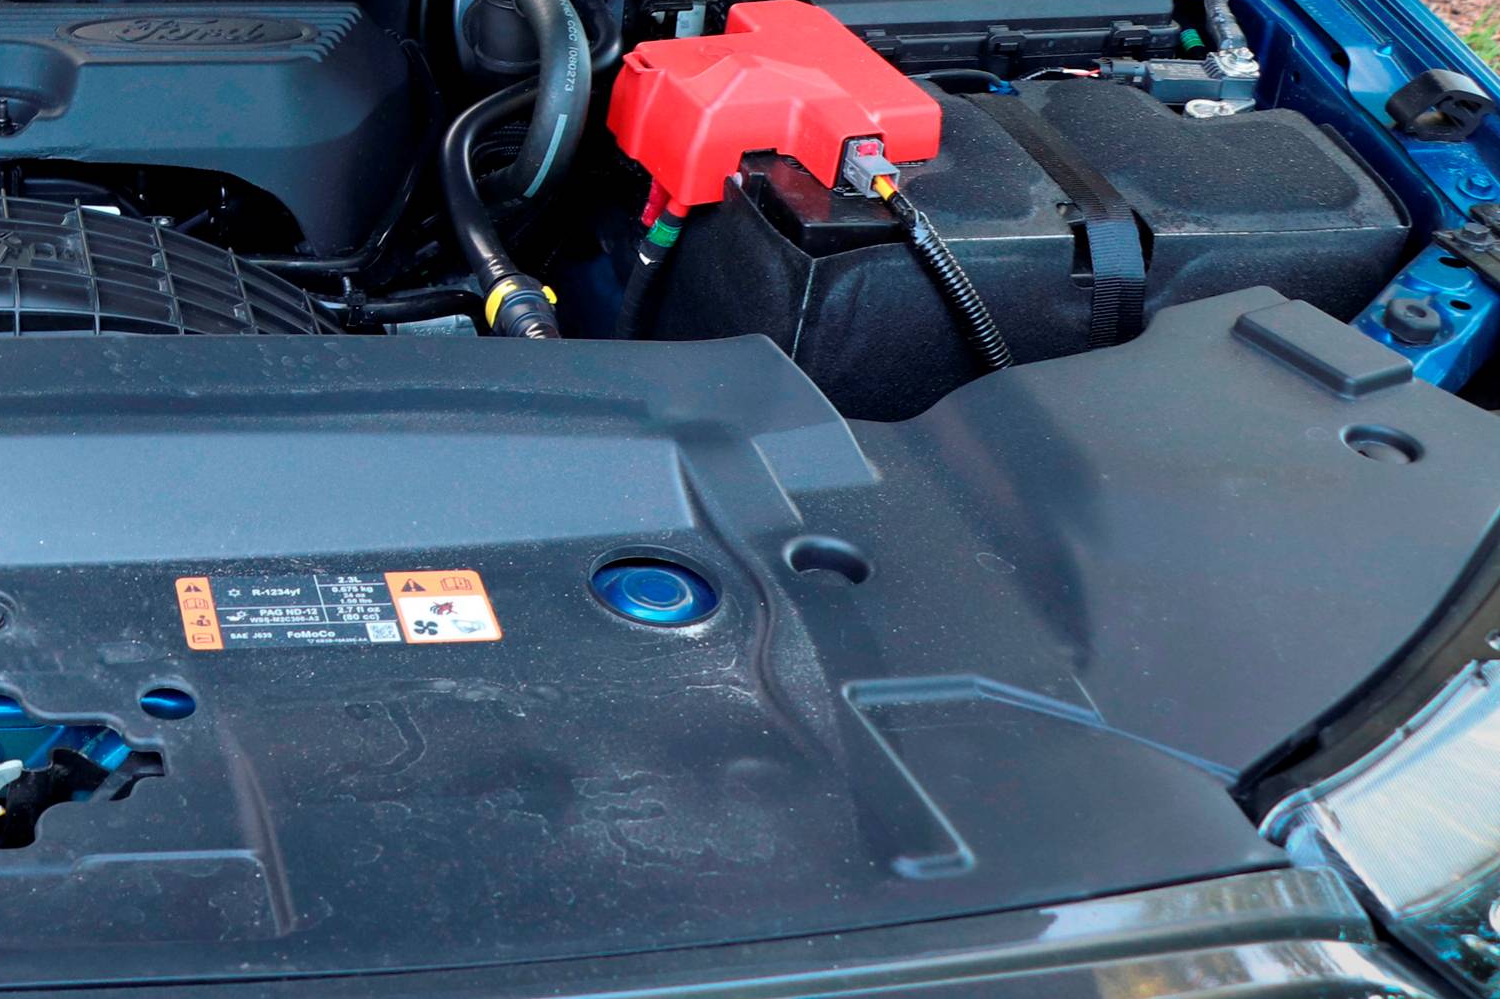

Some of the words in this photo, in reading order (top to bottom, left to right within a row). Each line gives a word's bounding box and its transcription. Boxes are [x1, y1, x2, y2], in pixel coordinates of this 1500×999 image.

[116, 19, 265, 42] Ford
[567, 20, 578, 42] CCC
[251, 588, 301, 596] R-1234yf
[362, 613, 380, 621] cc)
[287, 630, 336, 638] FoMoCo
